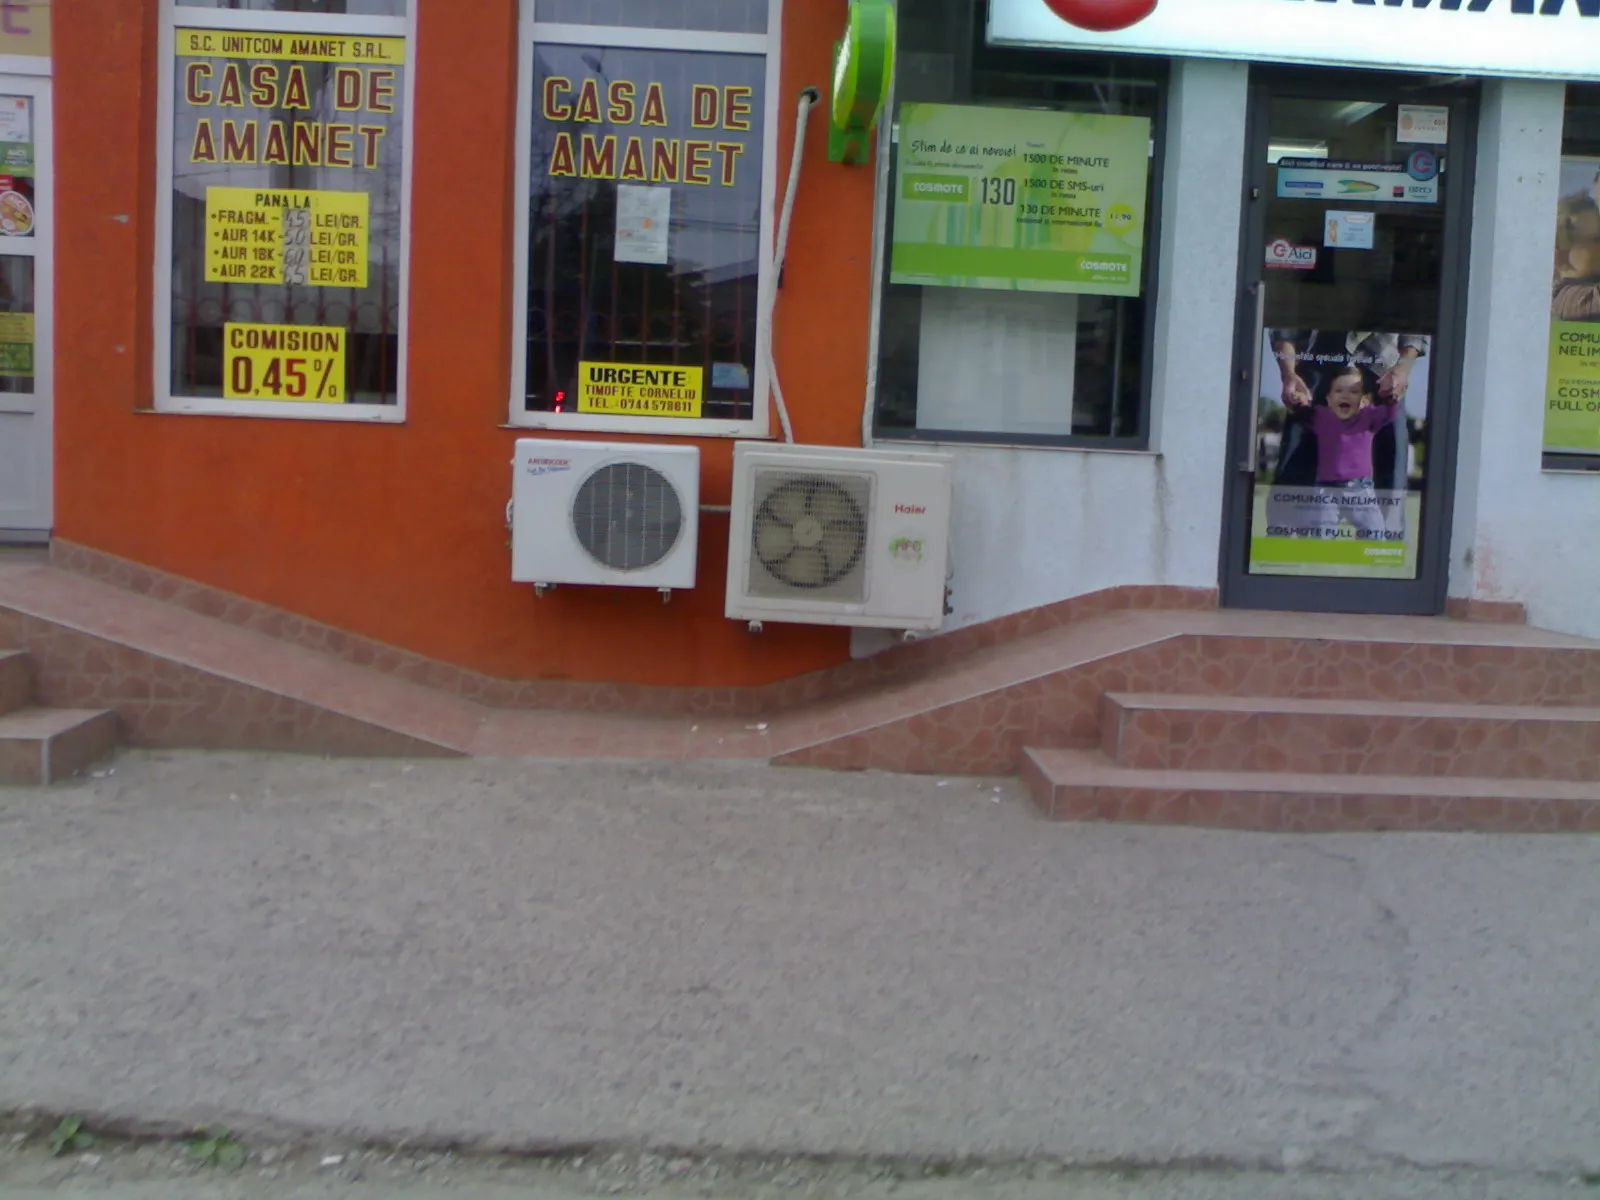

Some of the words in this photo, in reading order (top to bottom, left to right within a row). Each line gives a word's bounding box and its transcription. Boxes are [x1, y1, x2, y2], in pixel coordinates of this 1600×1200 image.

[190, 34, 216, 52] S.C.
[222, 37, 283, 54] UNITCOM
[290, 40, 345, 56] AMANET
[185, 61, 310, 110] CASA
[334, 67, 394, 113] DE
[543, 76, 668, 127] CASA
[691, 84, 752, 131] DE
[190, 118, 386, 169] AMANET
[940, 139, 953, 153] de
[548, 132, 744, 187] AMANET
[1023, 152, 1047, 164] 1500
[1049, 155, 1064, 165] DE
[1067, 156, 1110, 168] MINUTE
[980, 177, 1016, 206] 130
[1023, 177, 1048, 189] 1500
[1049, 179, 1065, 190] DE
[1067, 181, 1104, 192] SMS-uri
[255, 194, 290, 207] PANA
[293, 196, 311, 208] LA
[1020, 203, 1039, 215] 130
[1040, 204, 1056, 216] DE
[1058, 206, 1101, 218] MINUTE
[316, 214, 363, 229] LEI/GR.
[221, 230, 247, 243] AUR
[253, 232, 275, 244] 14K
[310, 232, 359, 247] LEI/GR.
[221, 248, 247, 261] AUR
[252, 249, 275, 262] 18K
[309, 250, 360, 264] LEI/GR.
[1288, 248, 1313, 261] Aici
[220, 265, 246, 278] AUR
[250, 266, 276, 279] 22K
[310, 268, 360, 282] LEI/GR.
[231, 329, 339, 352] COMISION
[232, 356, 337, 398] 0,45%
[590, 367, 686, 386] URGENTE
[585, 384, 633, 398] TIMOFTE
[1549, 400, 1582, 411] FULL
[1273, 493, 1338, 504] COMUNICA
[1341, 496, 1401, 507] NELIMITAT
[894, 504, 926, 515] Haier
[1325, 529, 1353, 539] FULL
